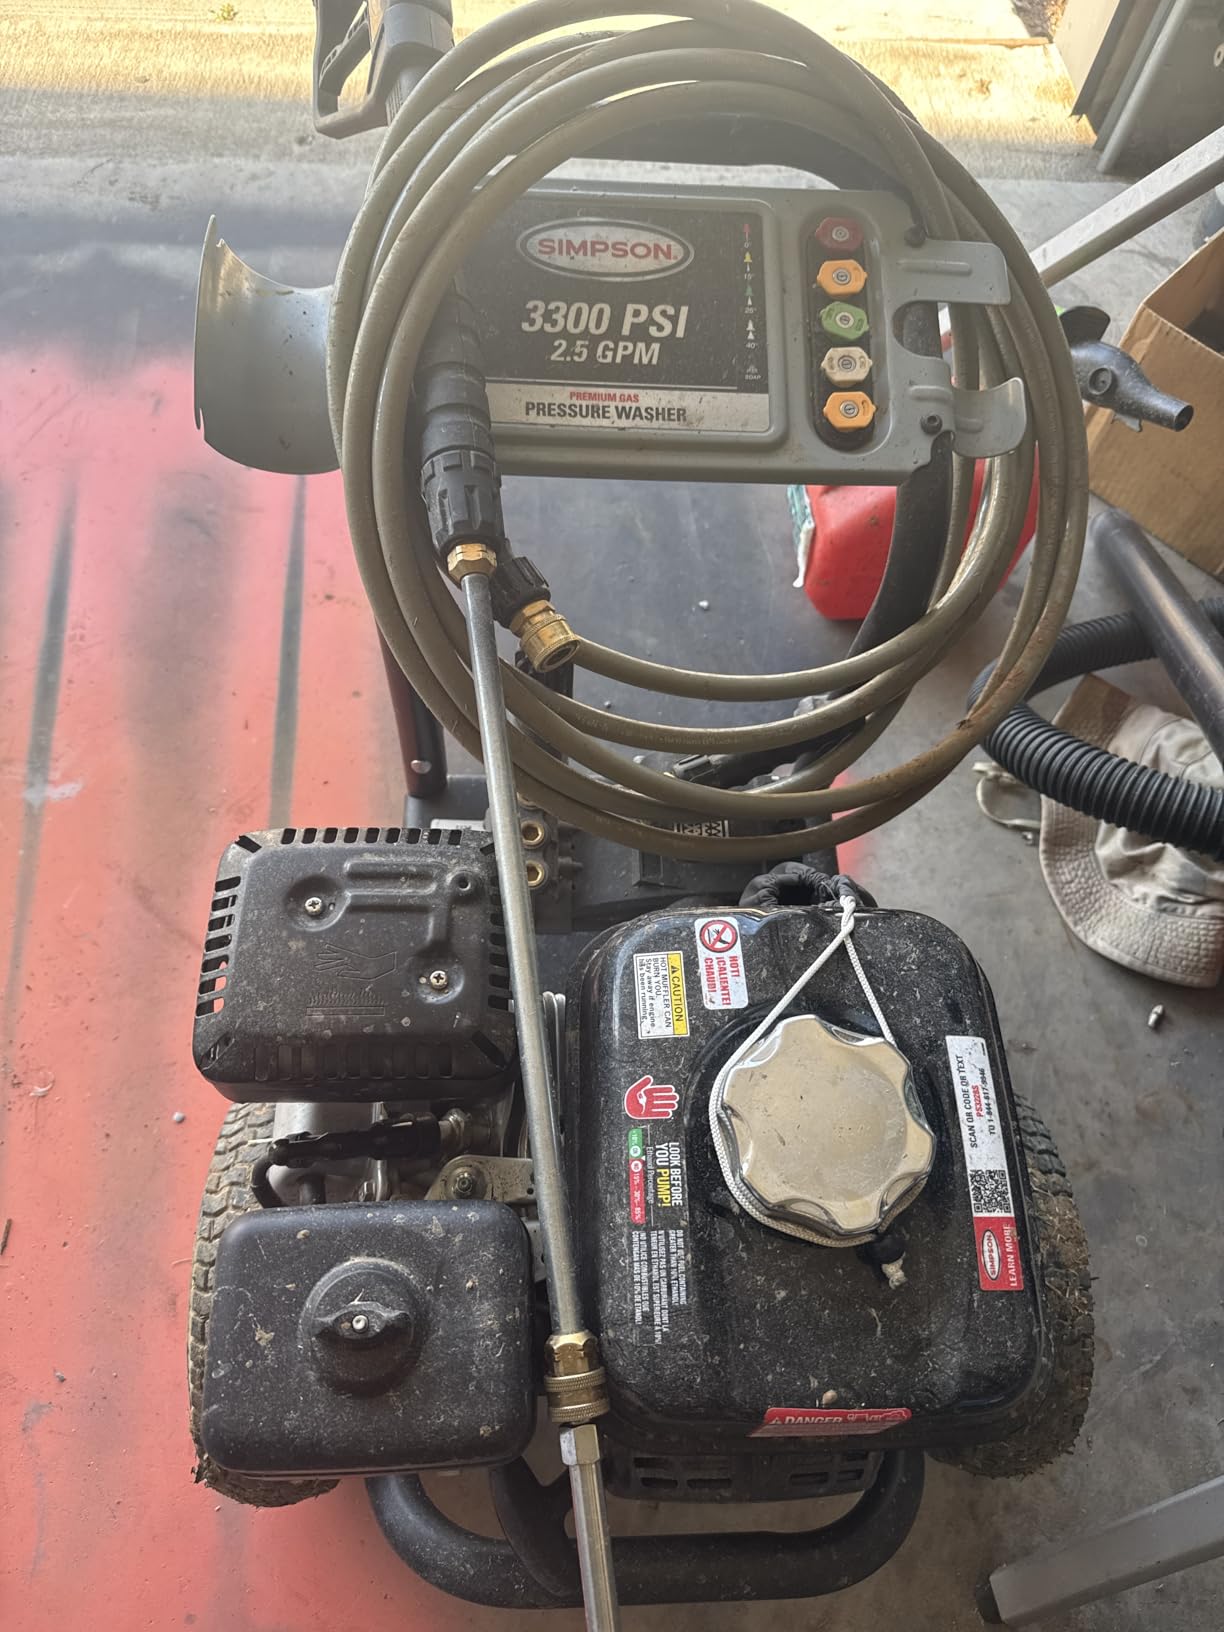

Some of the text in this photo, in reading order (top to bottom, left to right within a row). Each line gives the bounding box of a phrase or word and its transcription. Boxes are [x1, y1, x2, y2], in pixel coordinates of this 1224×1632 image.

[521, 300, 689, 338] 3300 PSI
[550, 339, 660, 365] 2.5 GPM
[569, 391, 640, 403] PREMIUM GAS
[525, 402, 687, 422] PRESSURE WASHER
[645, 958, 653, 974] Stay
[653, 958, 661, 978] BURN
[660, 957, 668, 971] HOT
[662, 974, 670, 1009] MUFFLER
[672, 976, 683, 1022] CAUTION
[648, 1002, 656, 1028] engine
[955, 1055, 965, 1075] TEXT
[961, 1089, 972, 1110] CODE
[968, 1125, 978, 1149] SCAN
[988, 1125, 996, 1136] TO
[655, 1142, 671, 1207] YOU PUMP!
[669, 1142, 683, 1206] LOOK BEFORE
[986, 1234, 996, 1276] SIMPSON
[1003, 1223, 1017, 1287] LEARN MORE
